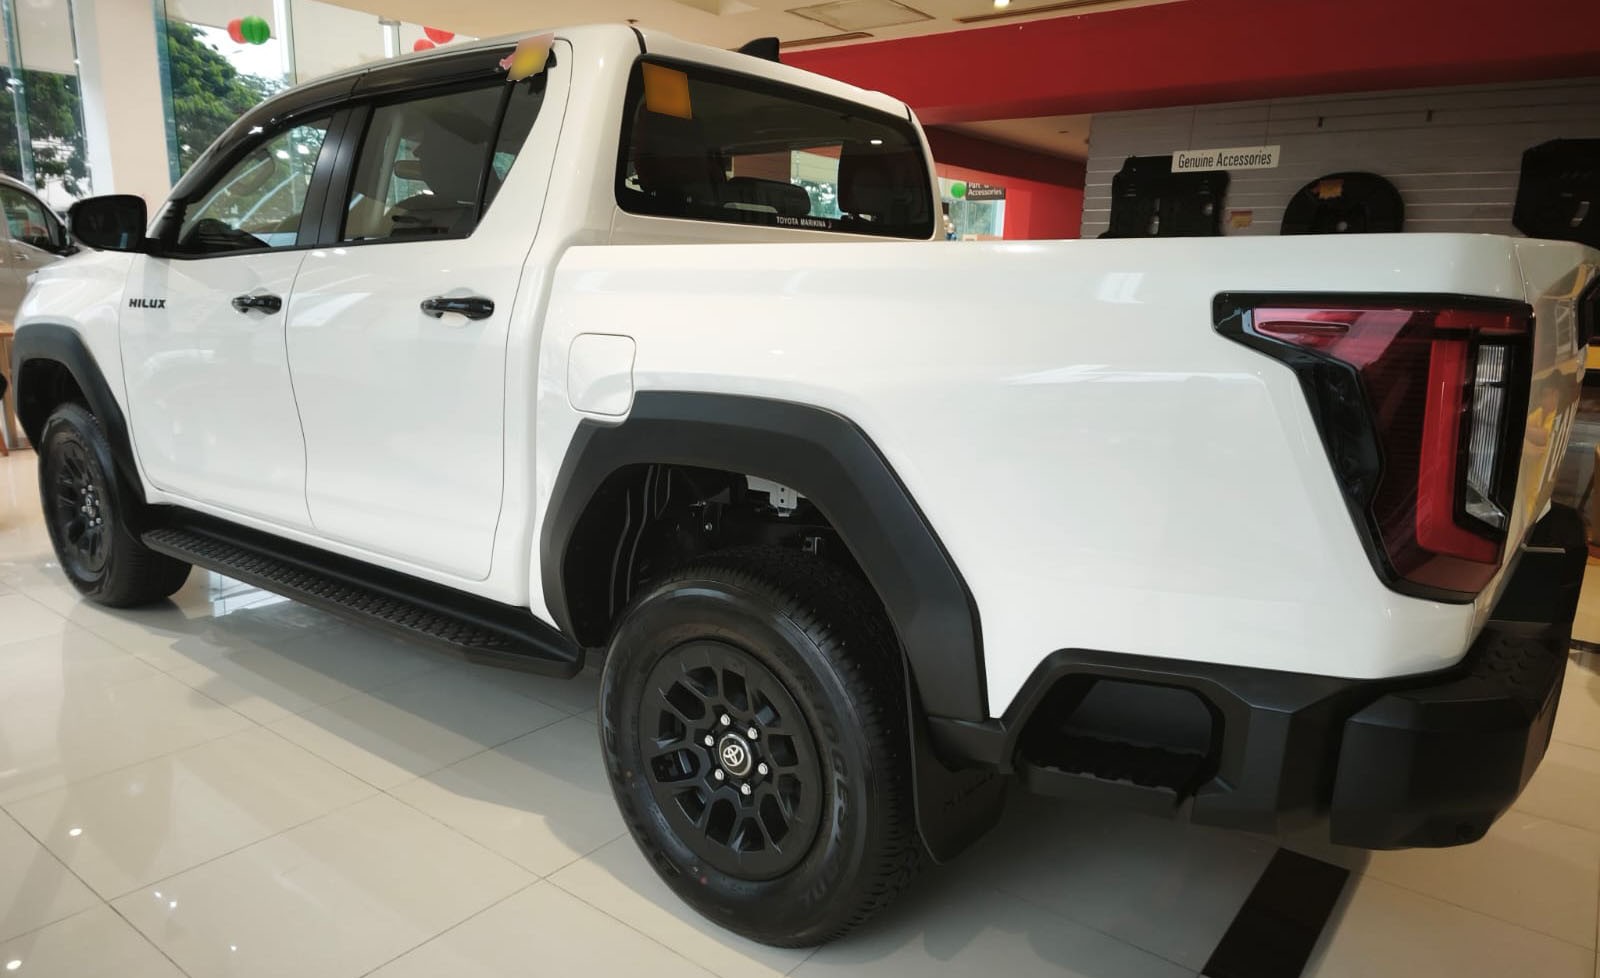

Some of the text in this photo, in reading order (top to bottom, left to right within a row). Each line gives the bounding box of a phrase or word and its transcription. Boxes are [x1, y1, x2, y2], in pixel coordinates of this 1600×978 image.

[1178, 151, 1272, 168] Genuine Accessories
[968, 188, 1003, 197] Accessories
[776, 216, 799, 226] TOYOTA
[800, 218, 826, 229] MARIKINA
[128, 298, 167, 309] HILUX
